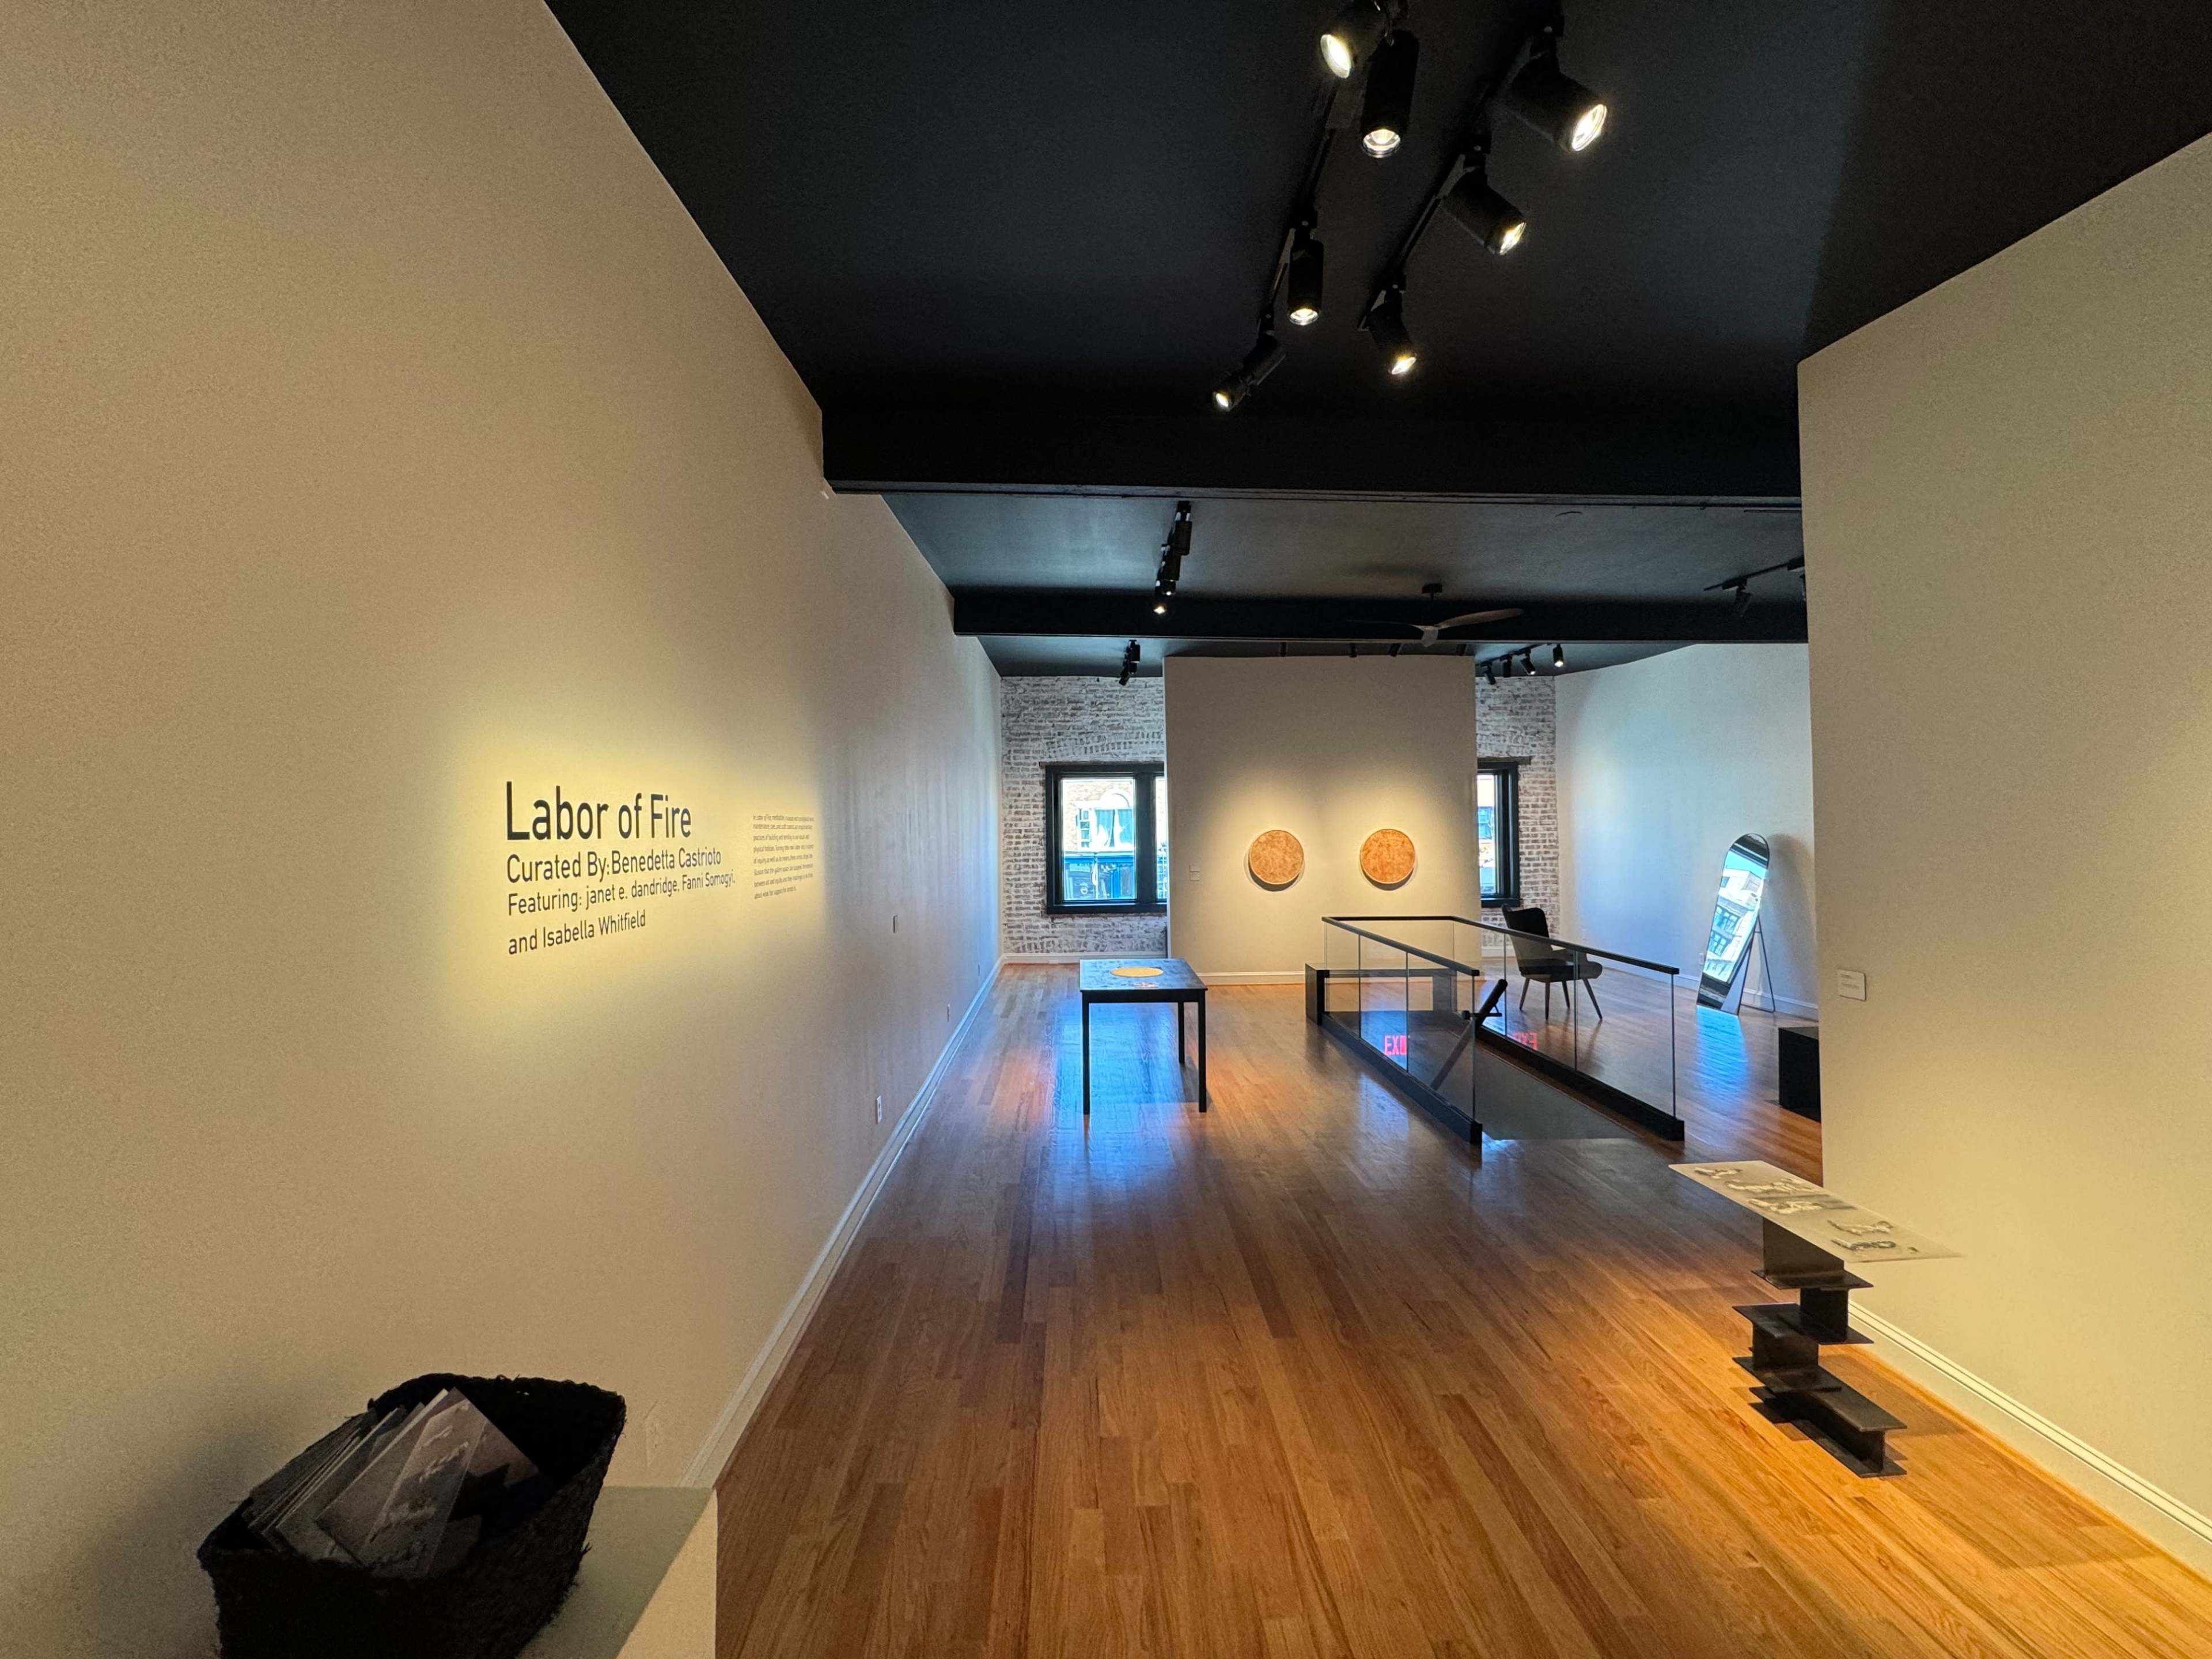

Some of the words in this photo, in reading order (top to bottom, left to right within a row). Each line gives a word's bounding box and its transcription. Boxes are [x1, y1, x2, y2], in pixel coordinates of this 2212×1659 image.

[506, 781, 609, 841] Labor
[618, 792, 643, 840] of
[650, 793, 692, 838] Fire
[507, 851, 581, 884] Curated
[611, 849, 675, 874] Benedetta
[679, 847, 722, 868] Castrioto
[508, 888, 582, 916] Featuring:
[585, 885, 616, 911] janet
[619, 887, 628, 900] e.
[682, 873, 704, 891] Fanni
[508, 926, 538, 956] and
[543, 915, 595, 949] Isabella
[597, 908, 646, 936] Whitfield
